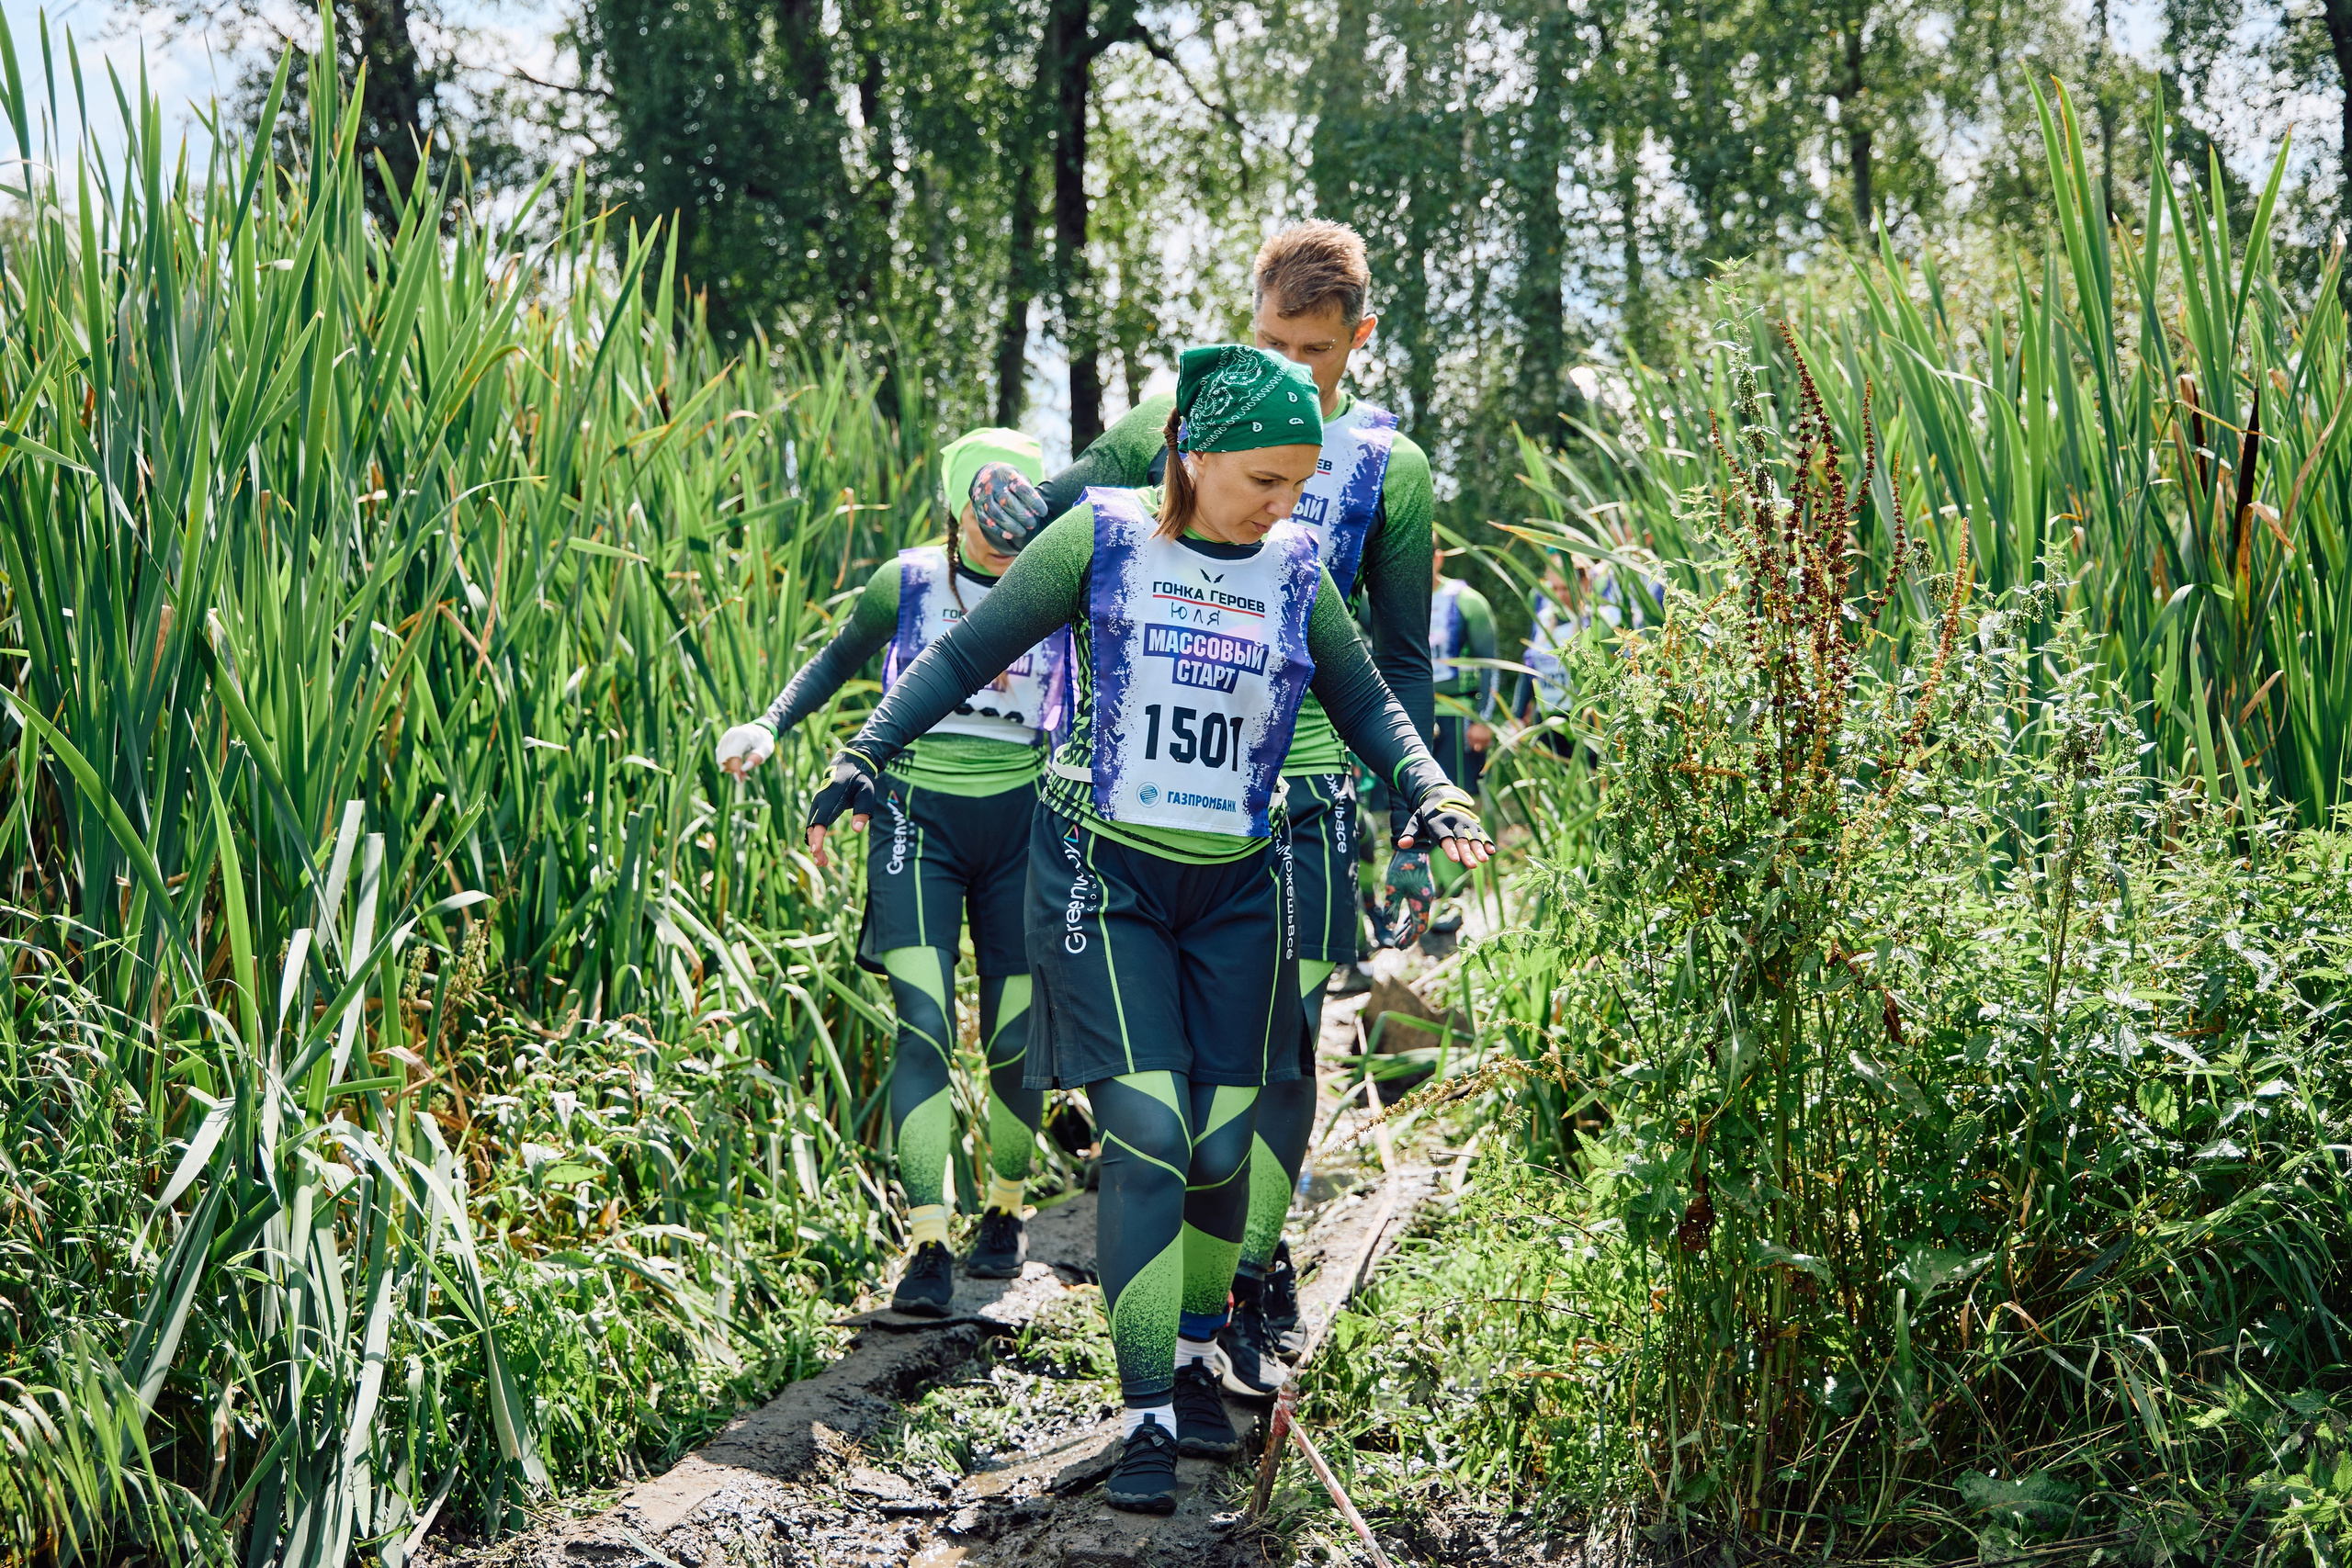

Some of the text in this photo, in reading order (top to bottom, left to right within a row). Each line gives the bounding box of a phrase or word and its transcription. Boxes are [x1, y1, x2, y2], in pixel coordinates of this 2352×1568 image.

[1152, 581, 1265, 614] ГОНКА ГЕРОЕВ
[1148, 628, 1265, 670] МАССОВЫЙ
[1176, 659, 1236, 690] СТАРТ
[1145, 704, 1244, 773] 1501
[1167, 791, 1237, 813] ГАЗПРОМБАНК
